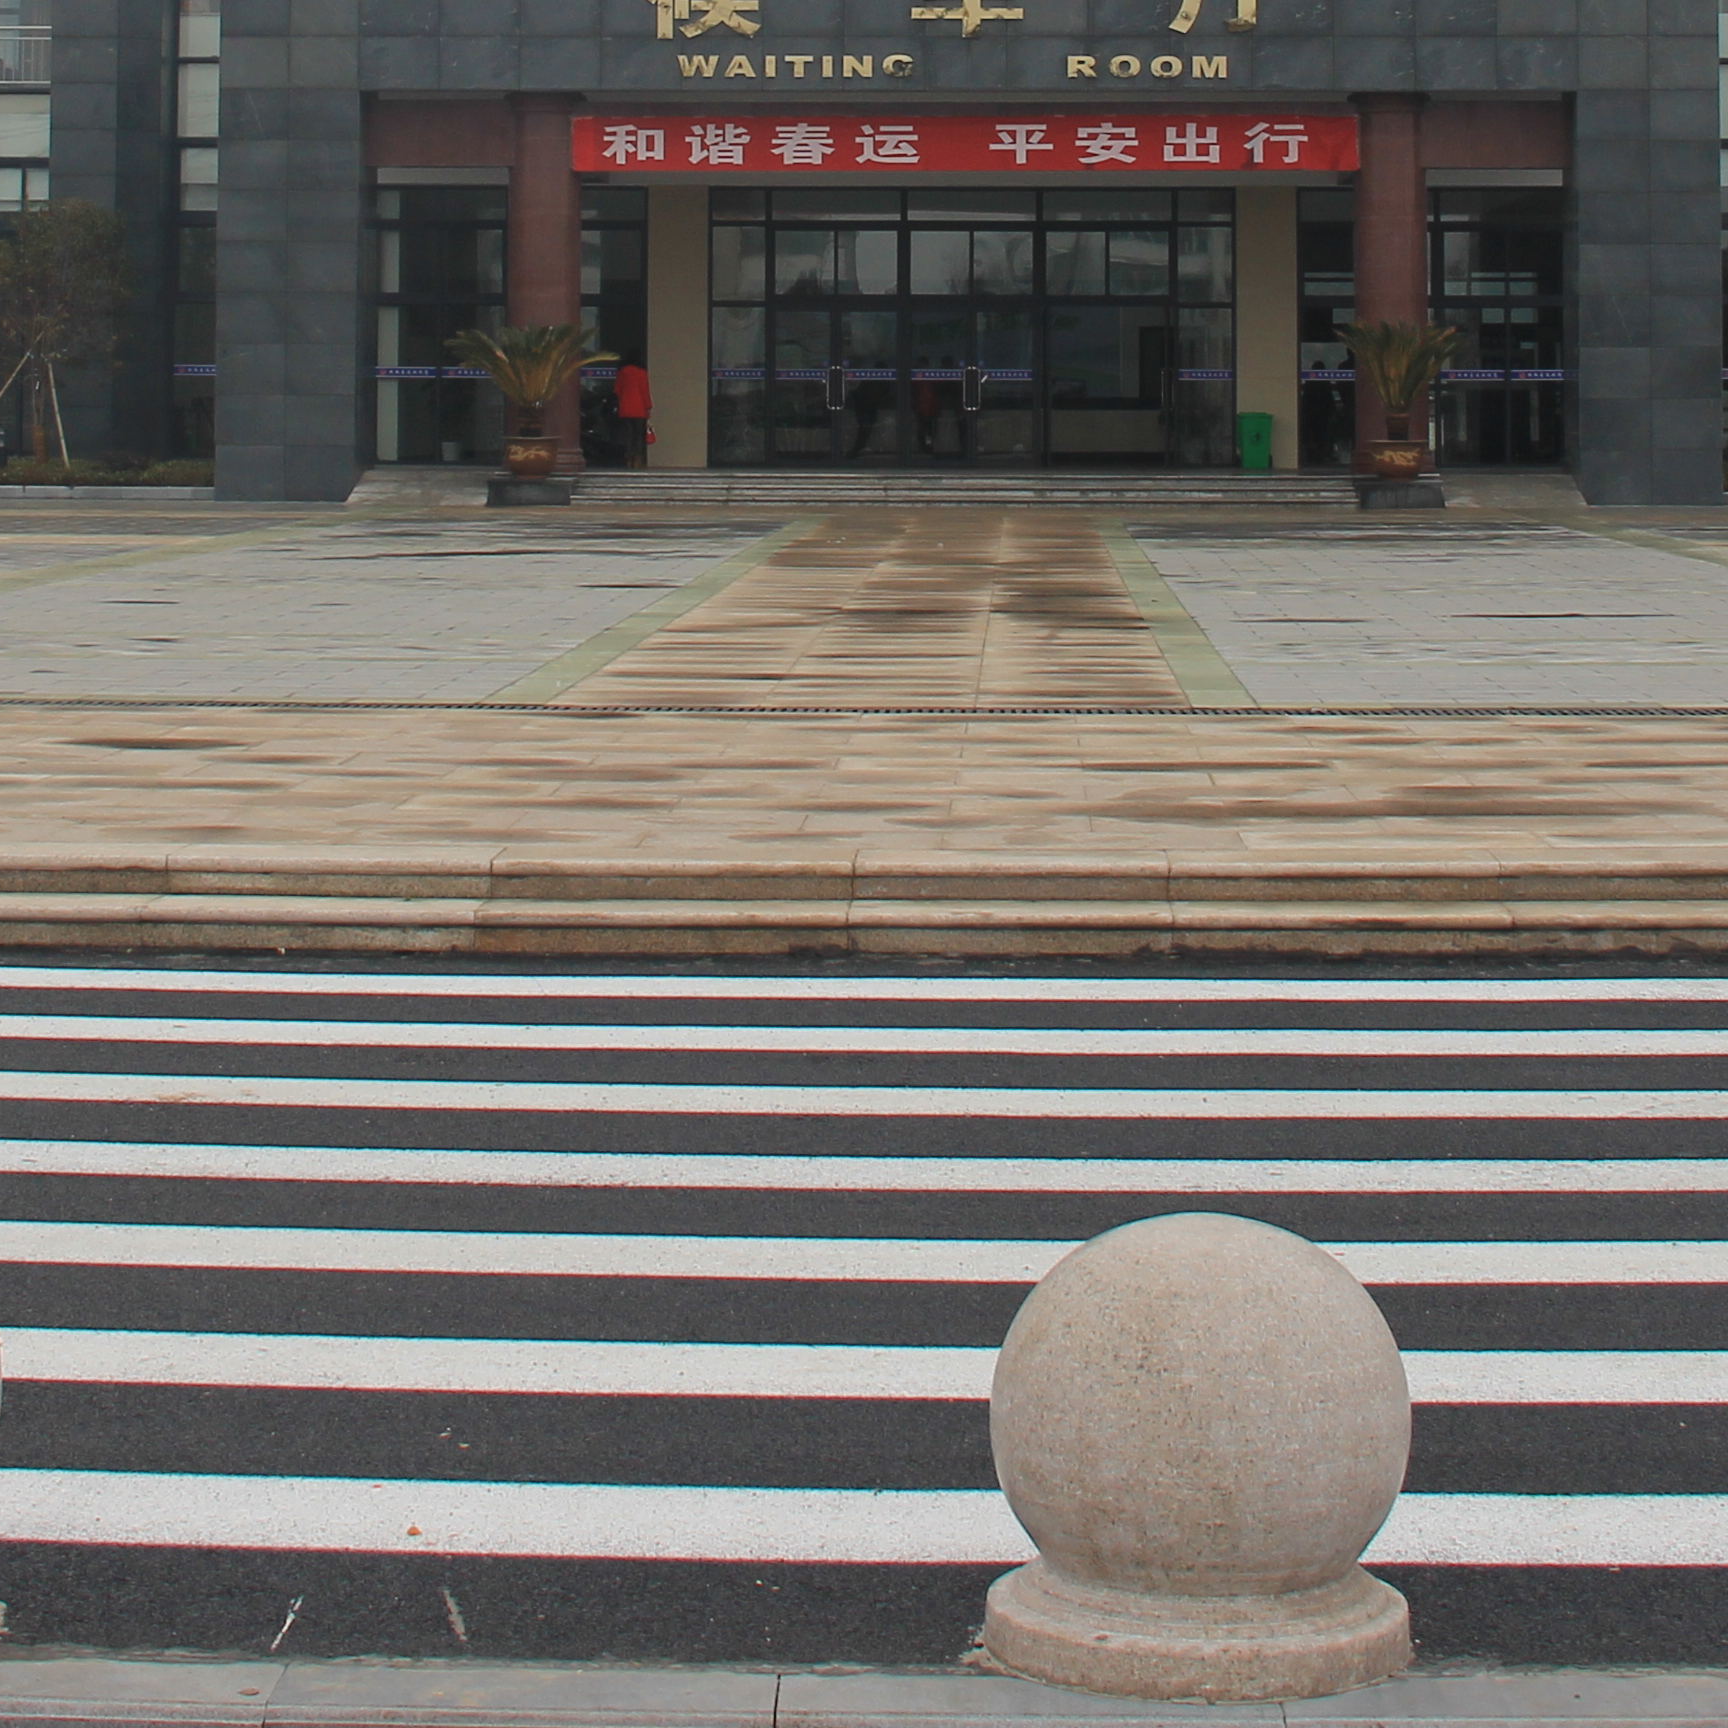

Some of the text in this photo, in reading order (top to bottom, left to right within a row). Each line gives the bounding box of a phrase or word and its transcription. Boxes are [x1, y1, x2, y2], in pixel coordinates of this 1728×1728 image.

[677, 54, 1230, 80] WAITING ROOM
[602, 122, 1310, 166] 和谐春运 平安出行
